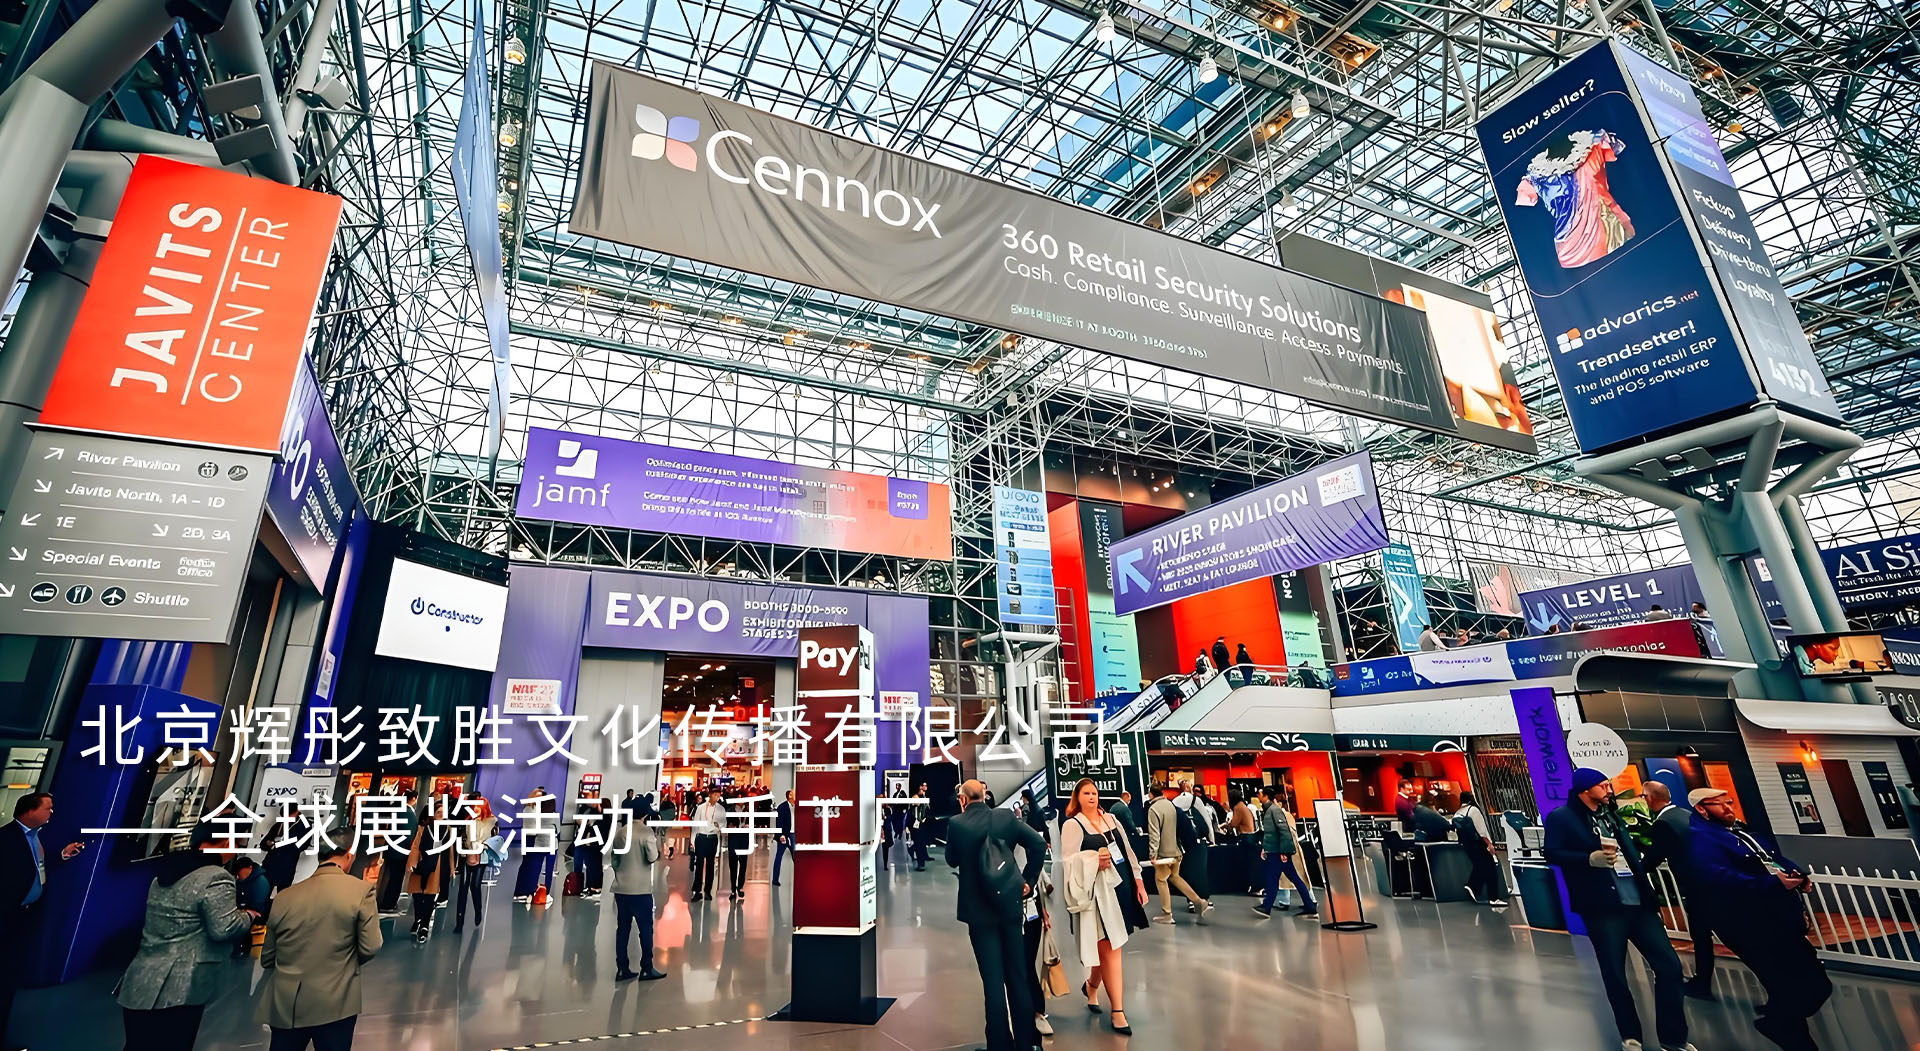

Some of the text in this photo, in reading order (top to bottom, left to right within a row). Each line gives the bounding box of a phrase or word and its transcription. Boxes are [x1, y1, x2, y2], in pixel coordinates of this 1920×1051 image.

[1502, 78, 1595, 144] Slow seller?
[706, 130, 942, 239] Cennox
[110, 202, 223, 394] JAVITS
[1002, 223, 1362, 344] 360 Retail Security Solutions
[200, 217, 289, 403] CENTER
[1004, 256, 1406, 375] Cash. Compliance. Surveillance. Access. Payments.
[1574, 337, 1717, 395] The leading retail ERP
[1577, 319, 1697, 374] Trendsetter!
[1590, 359, 1710, 405] and POS software
[78, 450, 181, 472] River Pavilion
[66, 482, 112, 498] Javits
[116, 488, 164, 504] North,
[171, 493, 188, 505] 1A
[532, 475, 611, 508] jamf
[56, 515, 76, 529] 1E
[182, 527, 231, 541] 2D, 3A
[1152, 523, 1204, 556] RIVER
[1209, 485, 1309, 536] PAVILION
[42, 549, 161, 570] Special Events
[1836, 550, 1879, 578] AI
[1882, 541, 1920, 571] Si
[134, 591, 190, 606] Shuttle
[605, 592, 731, 633] EXPO
[1562, 578, 1662, 609] LEVEL 1
[800, 640, 859, 676] Pay
[1528, 705, 1568, 801] Firework
[266, 787, 297, 796] EXPO
